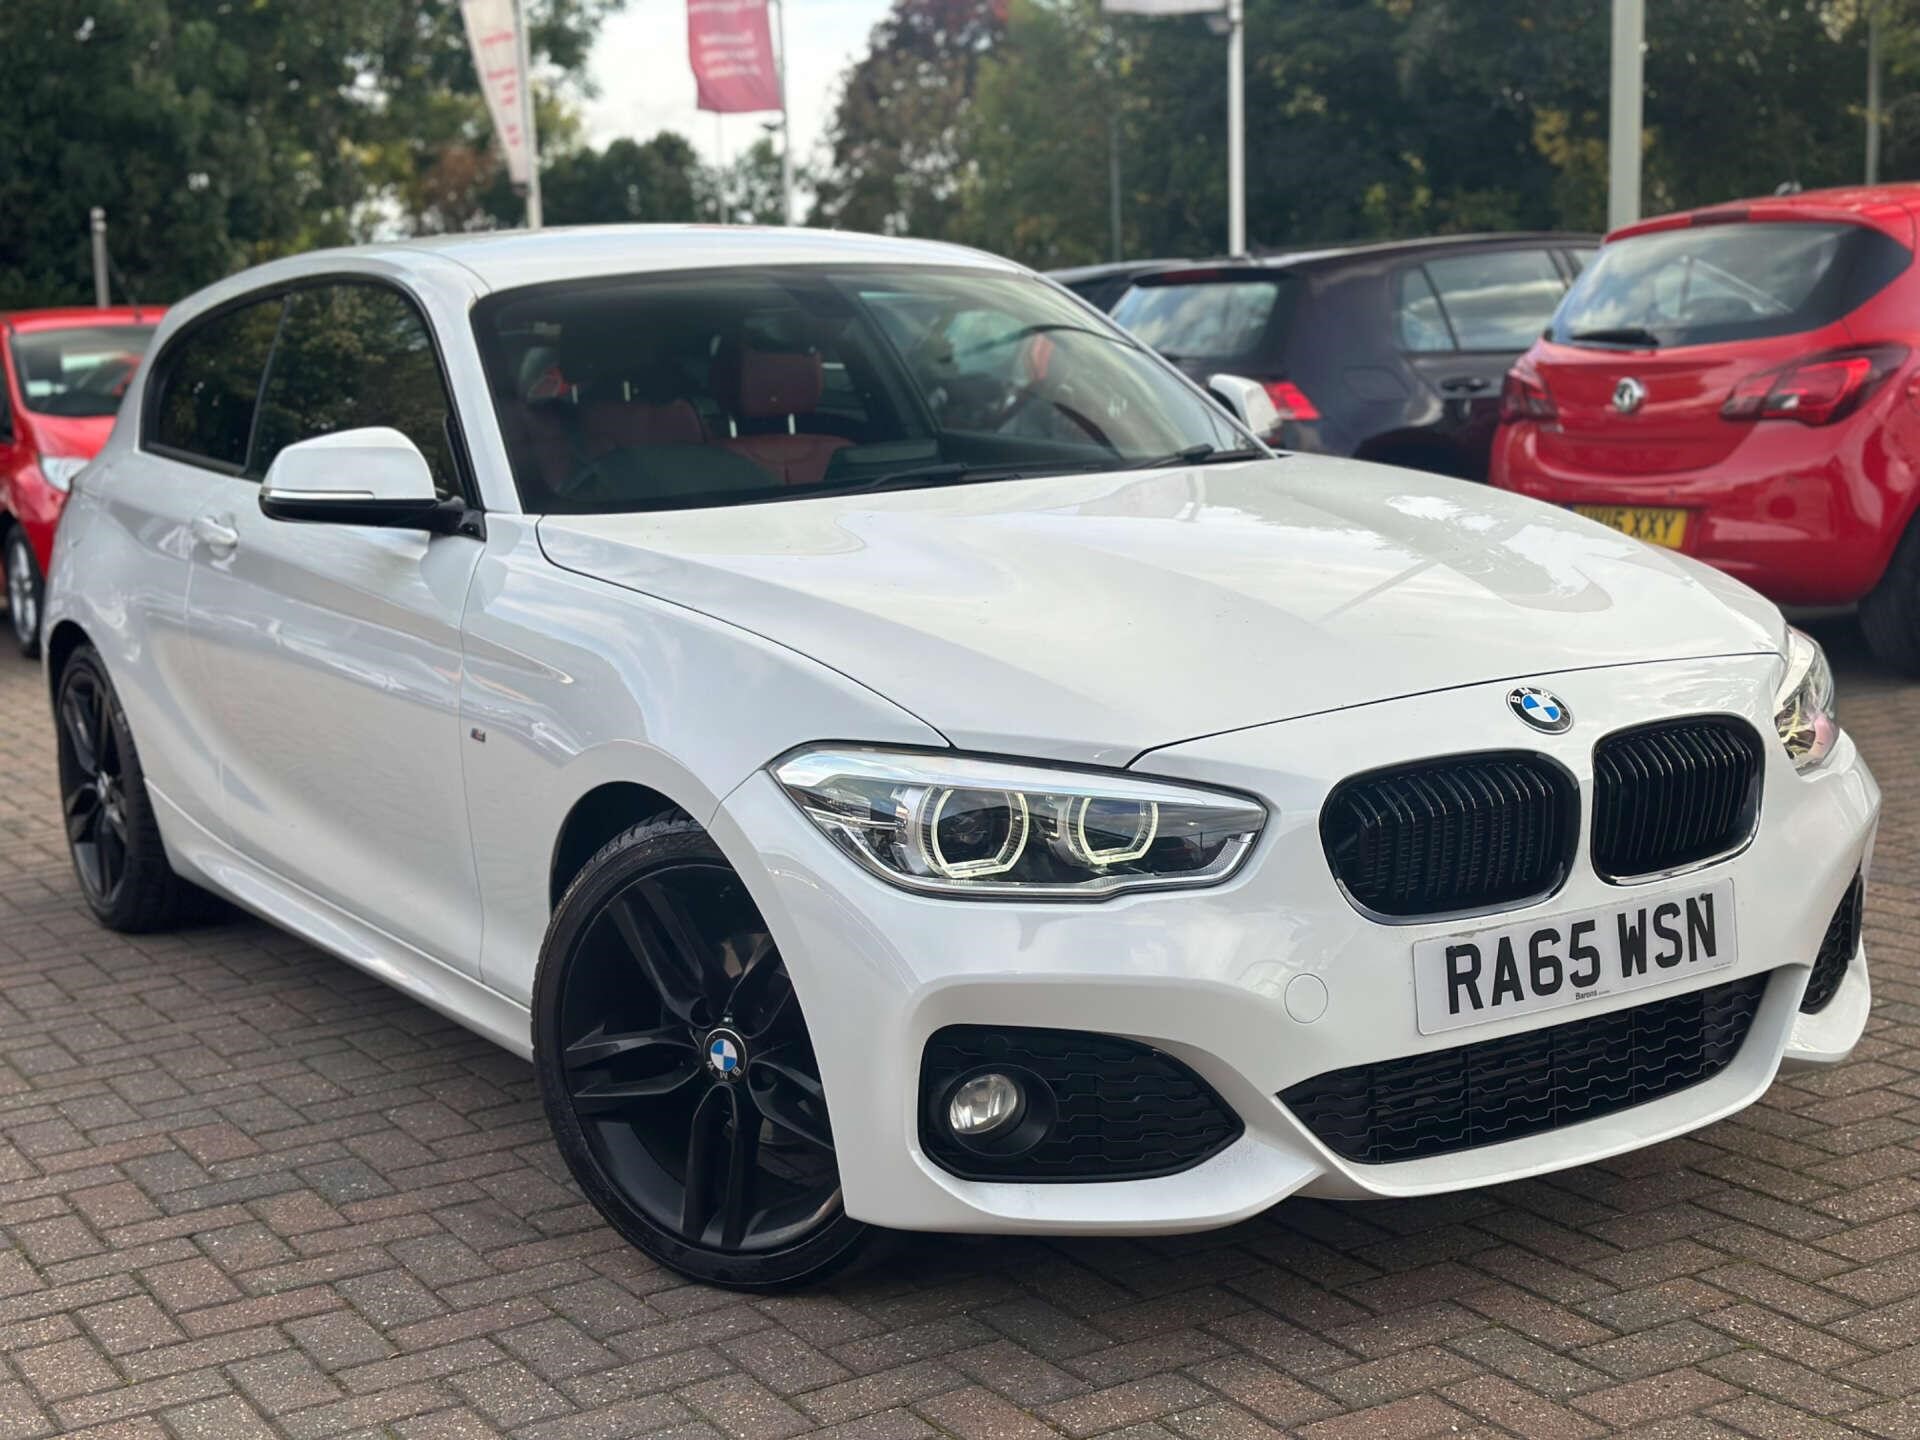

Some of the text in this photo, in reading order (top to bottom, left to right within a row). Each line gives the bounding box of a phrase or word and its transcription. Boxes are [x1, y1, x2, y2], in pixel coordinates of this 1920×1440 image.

[1630, 508, 1680, 541] XXY
[1445, 892, 1717, 1015] RA65 WSN
[706, 1060, 742, 1080] BMW
